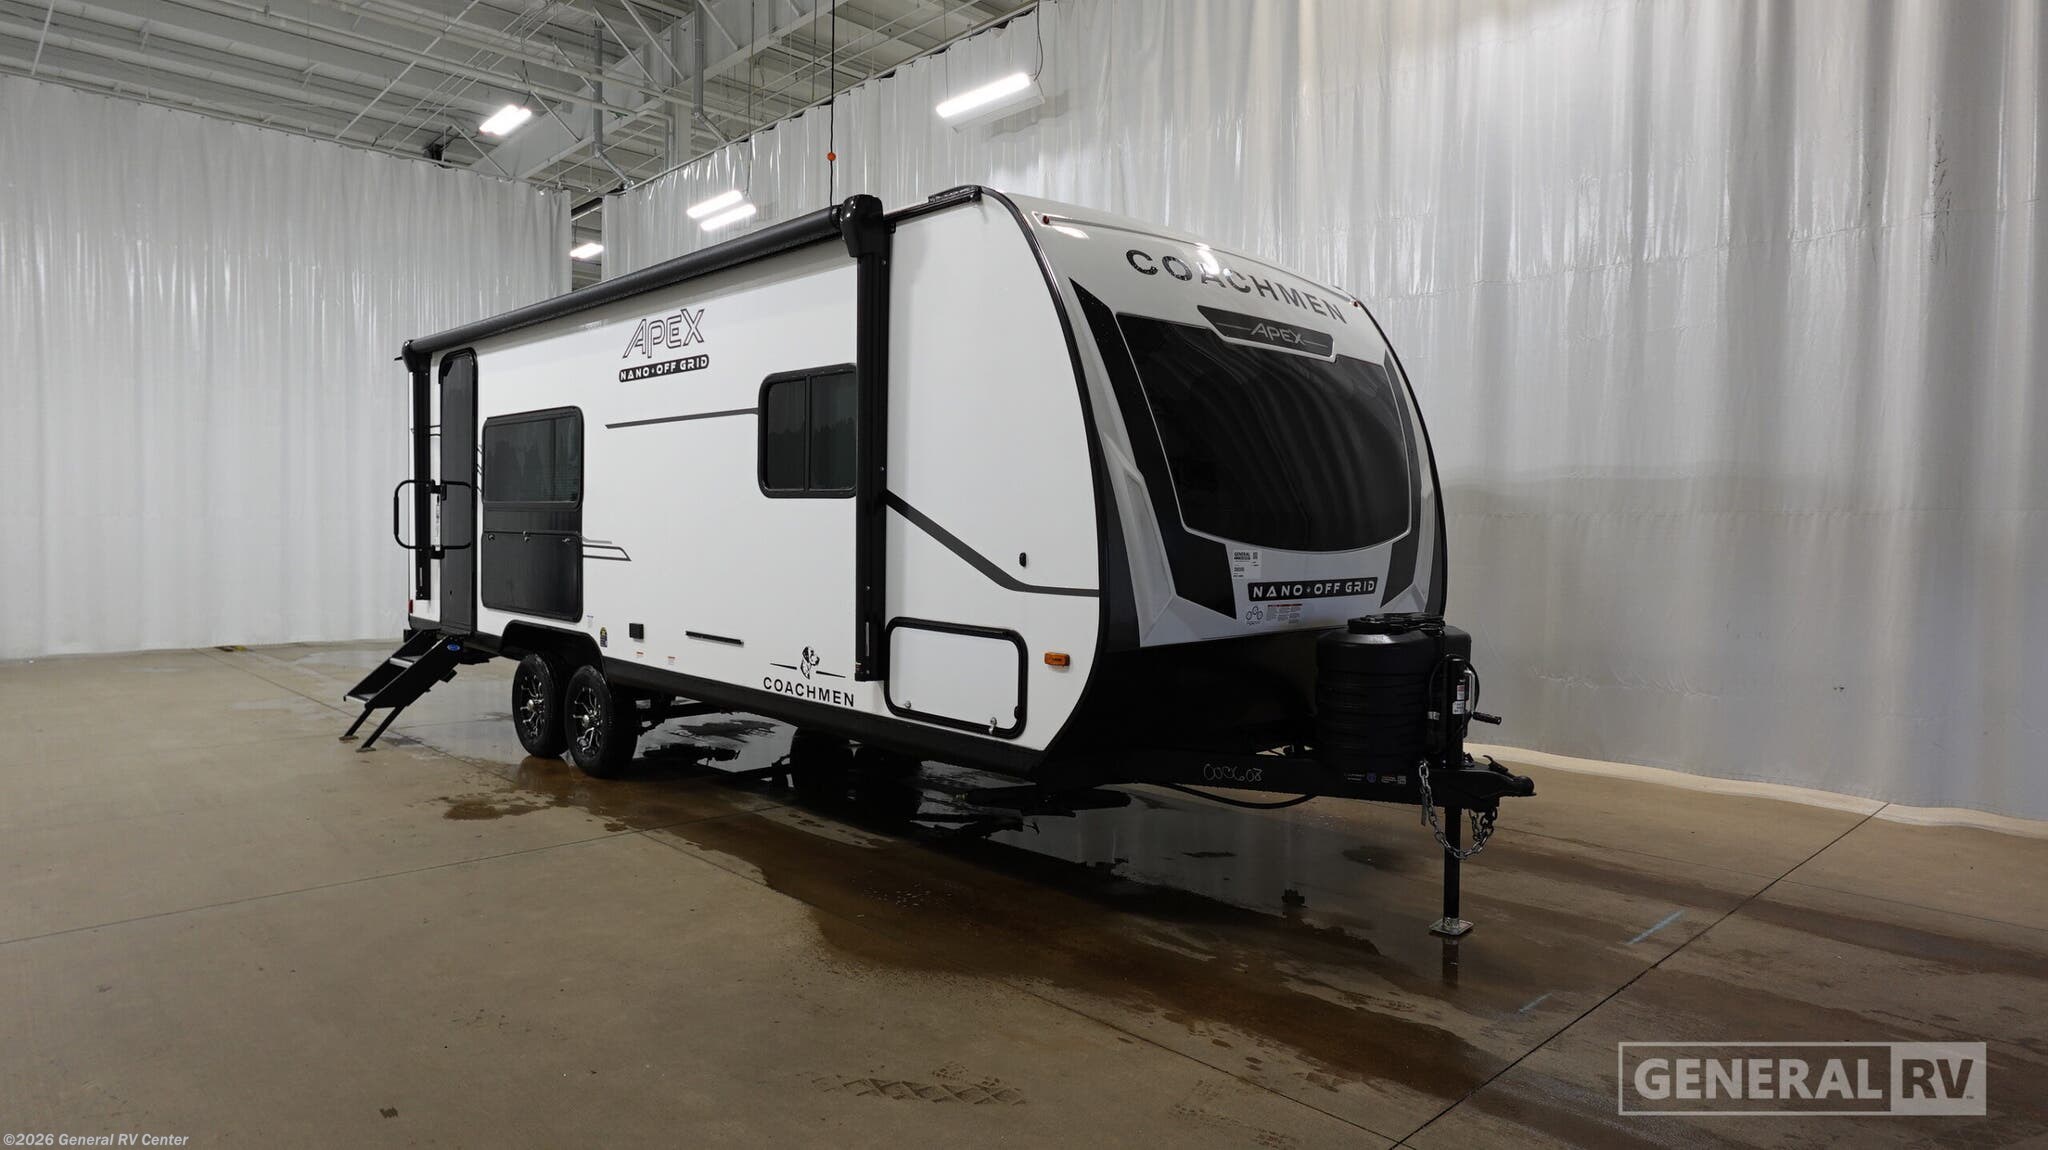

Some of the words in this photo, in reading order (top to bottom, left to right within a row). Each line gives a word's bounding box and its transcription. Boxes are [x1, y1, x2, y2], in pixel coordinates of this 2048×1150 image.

[1126, 249, 1347, 325] COACHMEN
[622, 308, 705, 359] APEX
[1250, 322, 1305, 346] APEX
[680, 356, 709, 371] GRID
[1345, 580, 1376, 593] GRID
[763, 676, 855, 708] COACHMEN
